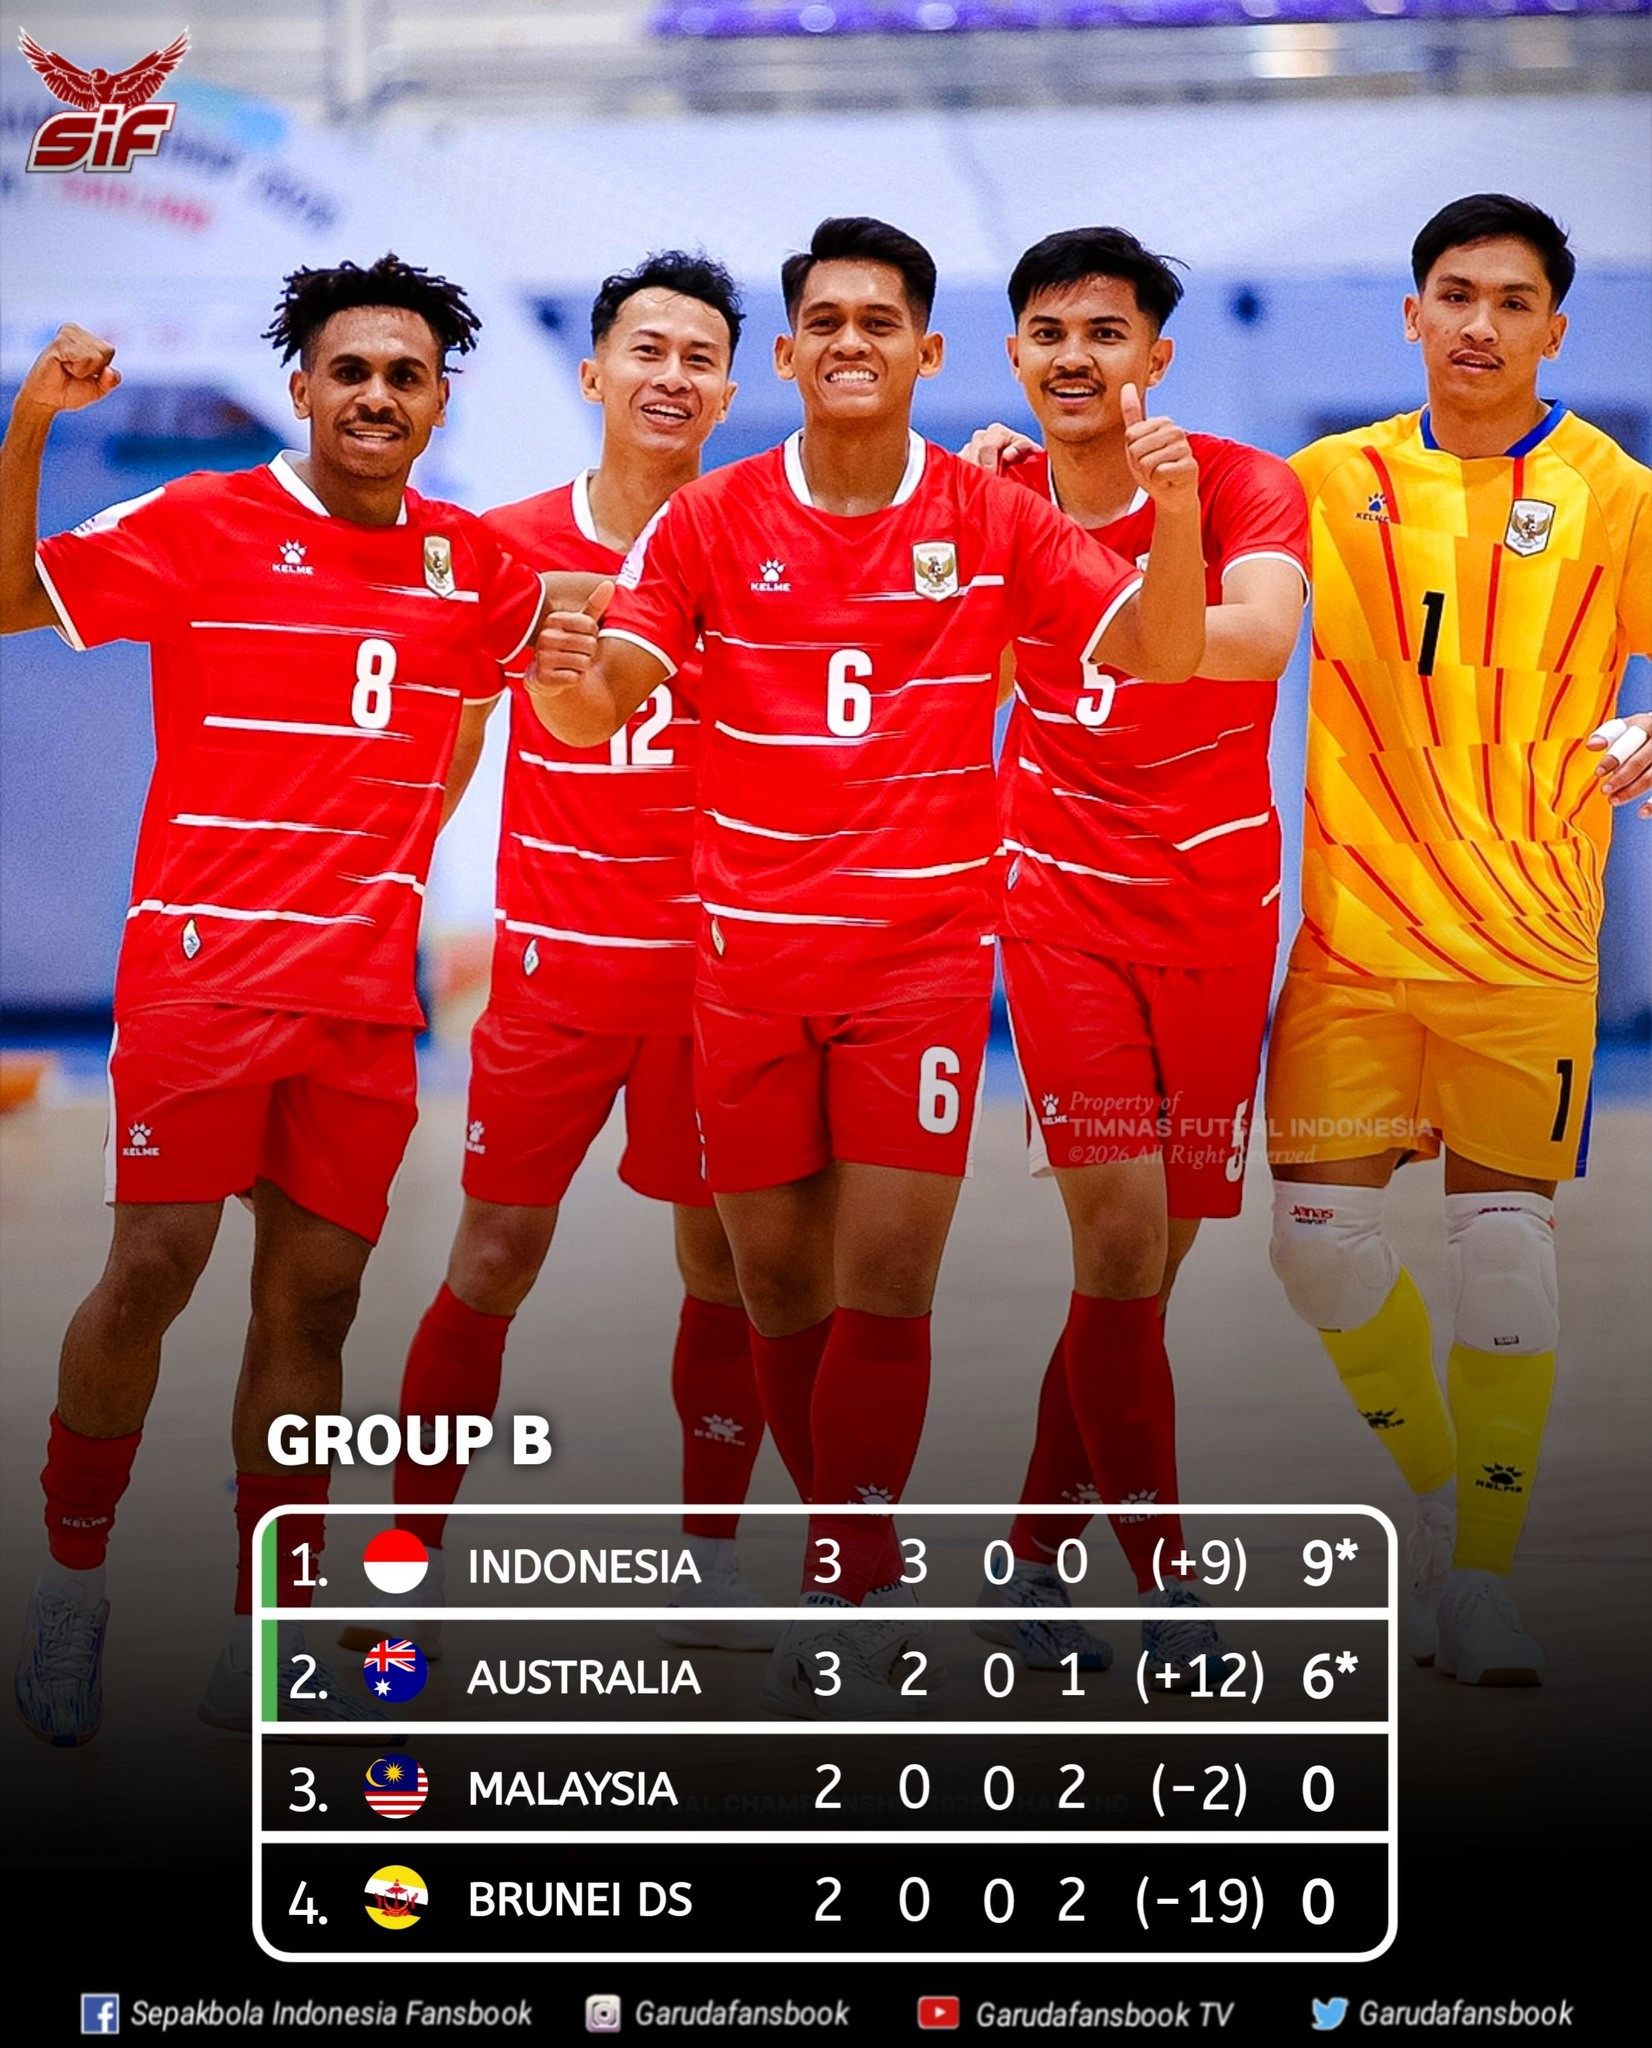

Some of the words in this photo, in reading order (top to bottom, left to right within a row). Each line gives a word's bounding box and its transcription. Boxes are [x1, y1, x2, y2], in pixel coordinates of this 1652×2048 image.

[271, 563, 314, 575] KELME
[750, 582, 791, 592] KELME
[1418, 591, 1445, 676] 1
[352, 638, 397, 728] 8
[610, 683, 674, 765] 12
[827, 649, 872, 736] 6
[1075, 662, 1116, 726] 5
[918, 1046, 960, 1134] 6
[1551, 1059, 1573, 1142] 1
[122, 1147, 160, 1156] KELME
[1119, 1512, 1161, 1524] KEL
